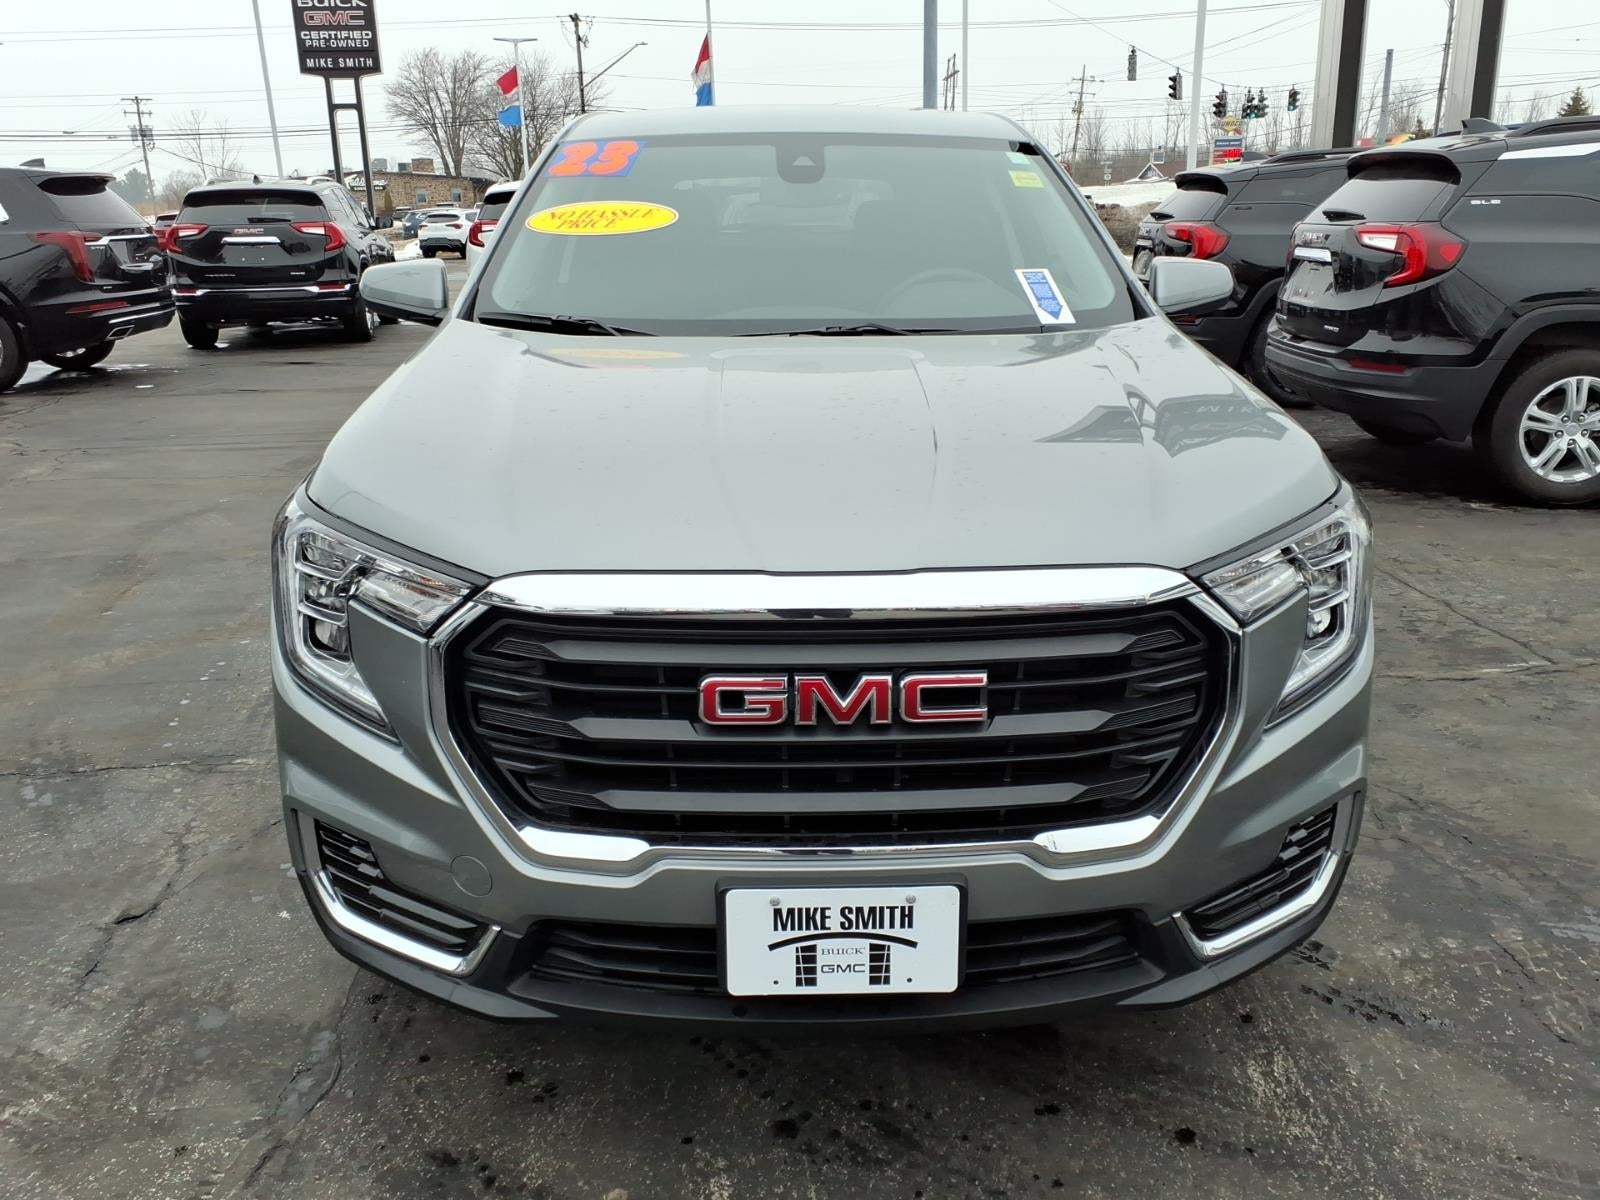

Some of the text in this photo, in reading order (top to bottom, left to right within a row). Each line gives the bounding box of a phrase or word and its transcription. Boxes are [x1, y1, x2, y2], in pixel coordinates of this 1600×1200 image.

[304, 11, 365, 26] GMC
[300, 30, 372, 39] CERTIFIED
[305, 40, 369, 48] PRE-OWNED
[306, 58, 373, 68] MIKE SMITH
[549, 140, 640, 177] 23
[698, 671, 988, 726] GMC
[773, 905, 914, 932] MIKE SMITH
[821, 948, 863, 956] BUICK
[820, 963, 866, 974] GMC
